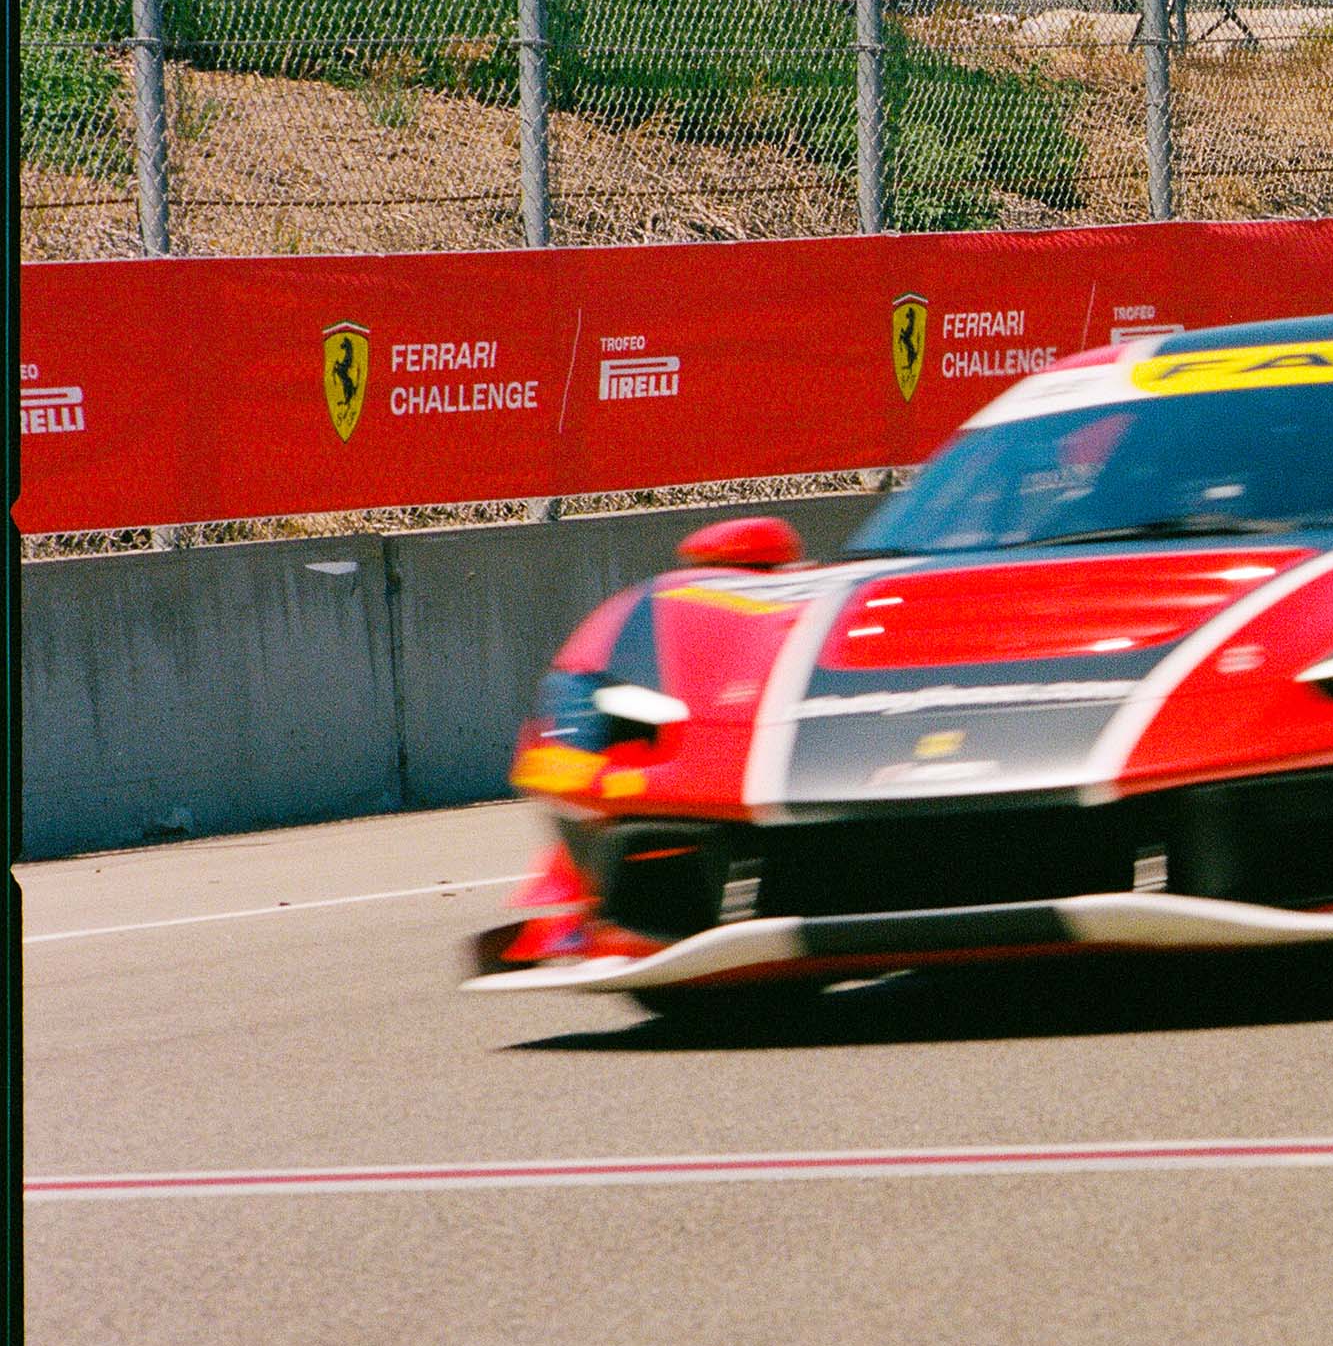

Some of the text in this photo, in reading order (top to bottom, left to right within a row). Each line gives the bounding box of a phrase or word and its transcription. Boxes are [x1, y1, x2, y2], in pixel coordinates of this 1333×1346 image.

[943, 310, 1025, 338] FERRARI
[1113, 305, 1156, 320] TROFEO
[391, 341, 498, 372] FERRARI
[600, 335, 646, 352] TROFEO
[942, 346, 1057, 379] CHALLENGE
[599, 356, 681, 401] PIRELLI
[390, 381, 539, 416] CHALLENGE
